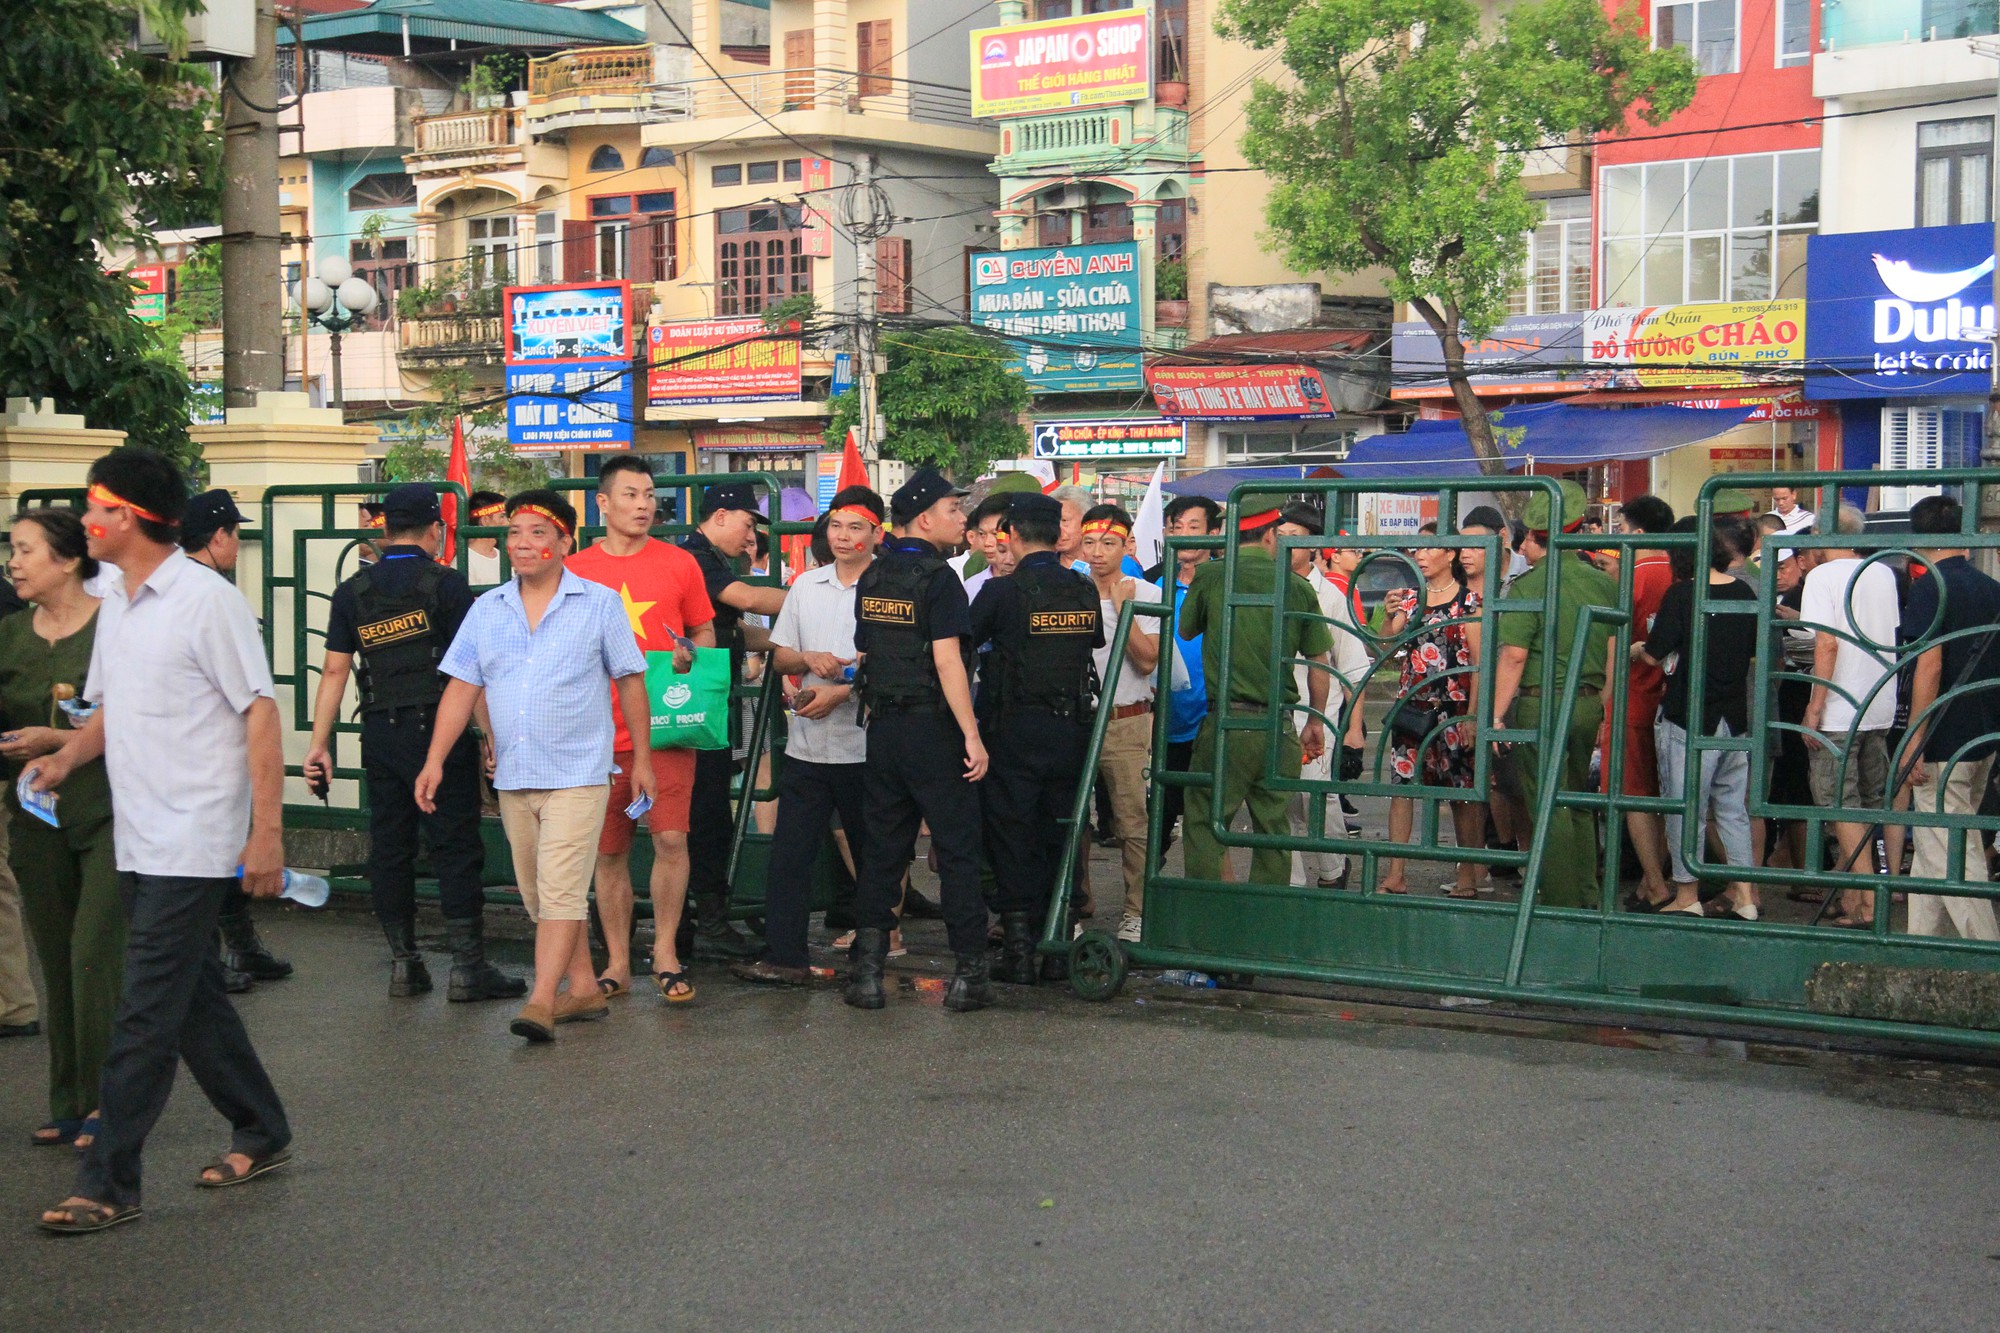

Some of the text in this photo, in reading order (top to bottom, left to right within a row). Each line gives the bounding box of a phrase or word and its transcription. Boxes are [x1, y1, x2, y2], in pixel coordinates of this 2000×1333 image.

[1014, 24, 1142, 67] JAPAN SHOP
[1017, 64, 1137, 92] THẾ GIỚI HÀNG NHẬT
[1011, 251, 1133, 279] QUYỀN ANH
[978, 281, 1132, 312] MUA BÁN SỬA CHỮA
[527, 316, 576, 334] XUYÊN
[1004, 313, 1040, 336] KÍNH
[1041, 310, 1077, 338] ĐIỆN
[1079, 311, 1126, 336] THOẠI
[1591, 311, 1702, 330] Phố Đêm Quán
[1874, 298, 1995, 343] Dulu
[669, 326, 692, 338] ĐOÀN
[693, 325, 712, 338] LUẬT
[713, 325, 725, 336] SƯ
[1591, 315, 1799, 359] ĐỒ NƯỚNG CHÁO
[521, 346, 546, 356] CUNG
[547, 341, 566, 355] CẤP
[1708, 346, 1789, 361] BÚN PHỞ
[1154, 371, 1175, 380] BÁN
[1177, 370, 1205, 380] BUÔN
[1214, 370, 1235, 379] BÁN
[1257, 368, 1284, 378] THAY
[1289, 364, 1308, 377] THẾ
[1173, 377, 1304, 414] PHỤ TÙNG XE MÁY GIÁ RẺ
[515, 400, 619, 426] MÁY IN CAMERA
[522, 431, 538, 440] LINH
[539, 431, 553, 441] PHỤ
[554, 430, 570, 441] KIỆN
[571, 429, 591, 440] CHÍNH
[704, 434, 719, 445] VĂN
[720, 432, 747, 445] PHÒNG
[747, 432, 766, 445] LUẬT
[768, 432, 779, 444] SƯ
[1059, 426, 1073, 440] SỬA
[1074, 427, 1094, 440] CHỮA
[1097, 426, 1107, 439] ÉP
[1107, 426, 1125, 439] KÍNH
[1129, 427, 1147, 438] THAY
[1163, 425, 1182, 437] HÌNH
[1380, 497, 1419, 514] XE MÁY
[1380, 516, 1418, 529] XE ĐẠP ĐIỆN
[864, 599, 912, 616] SECURITY
[360, 612, 423, 640] SECURITY
[1032, 613, 1094, 627] SECURITY
